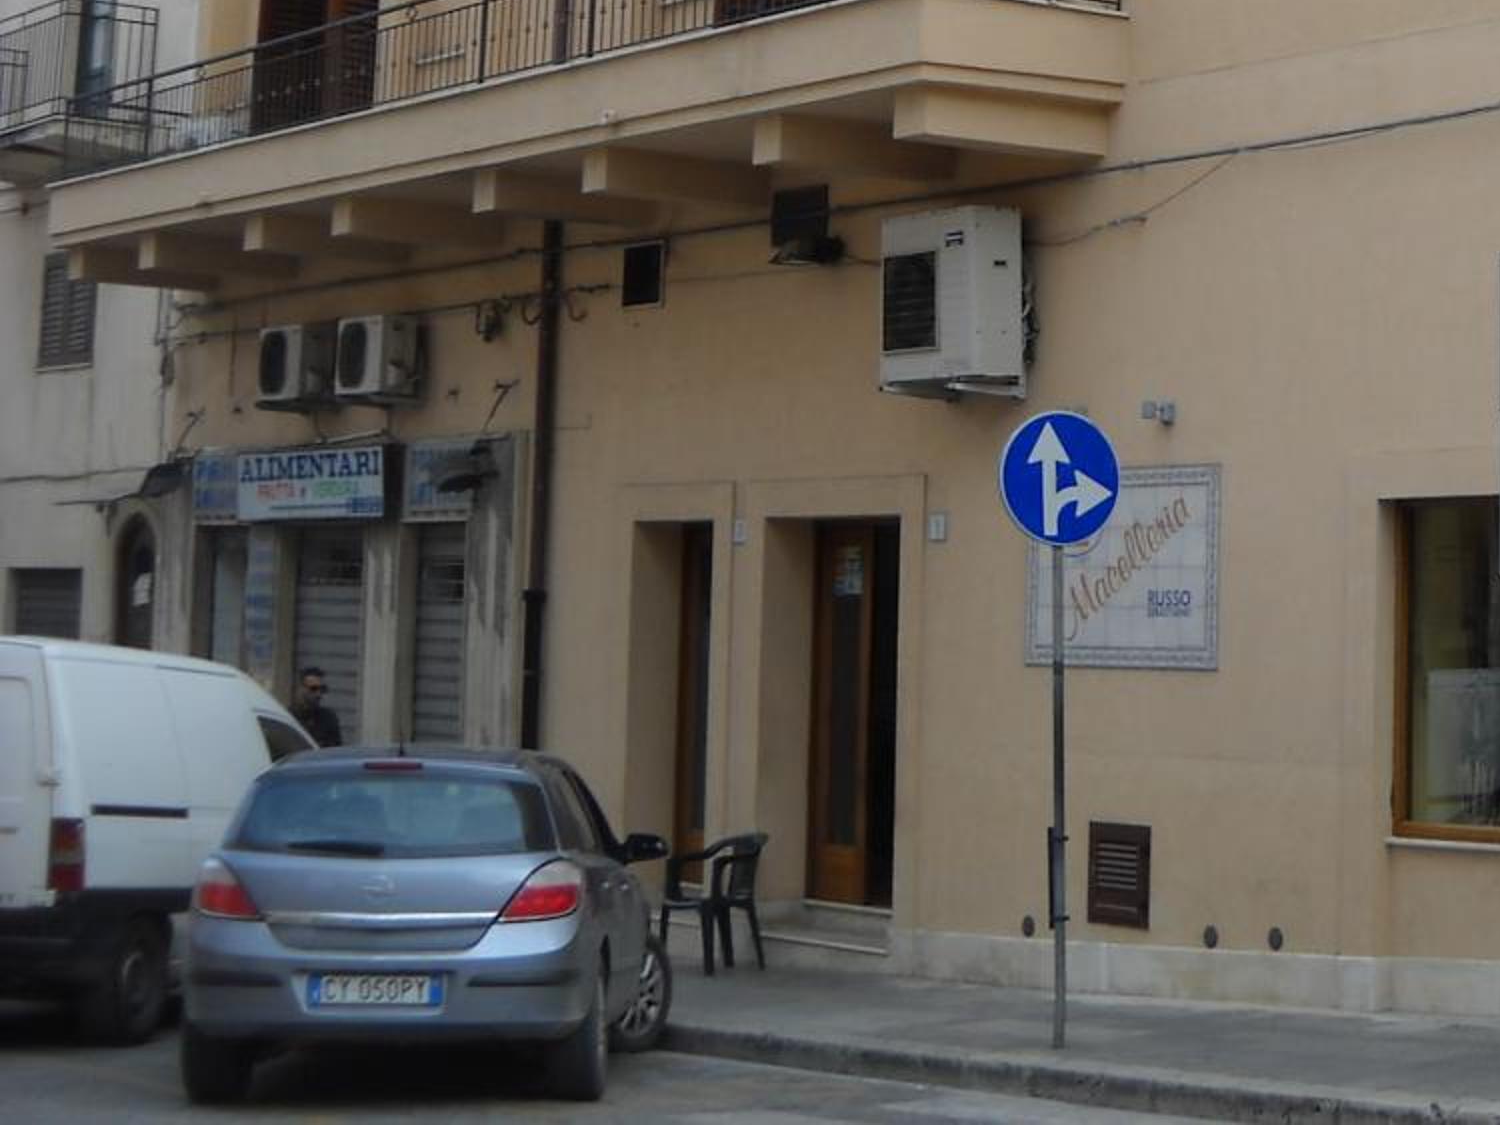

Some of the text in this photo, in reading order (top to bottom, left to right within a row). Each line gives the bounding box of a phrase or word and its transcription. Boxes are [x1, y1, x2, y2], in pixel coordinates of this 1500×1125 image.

[240, 450, 380, 483] ALIMENTARI
[1066, 496, 1192, 642] Macelleria
[1148, 589, 1191, 607] RUSSO
